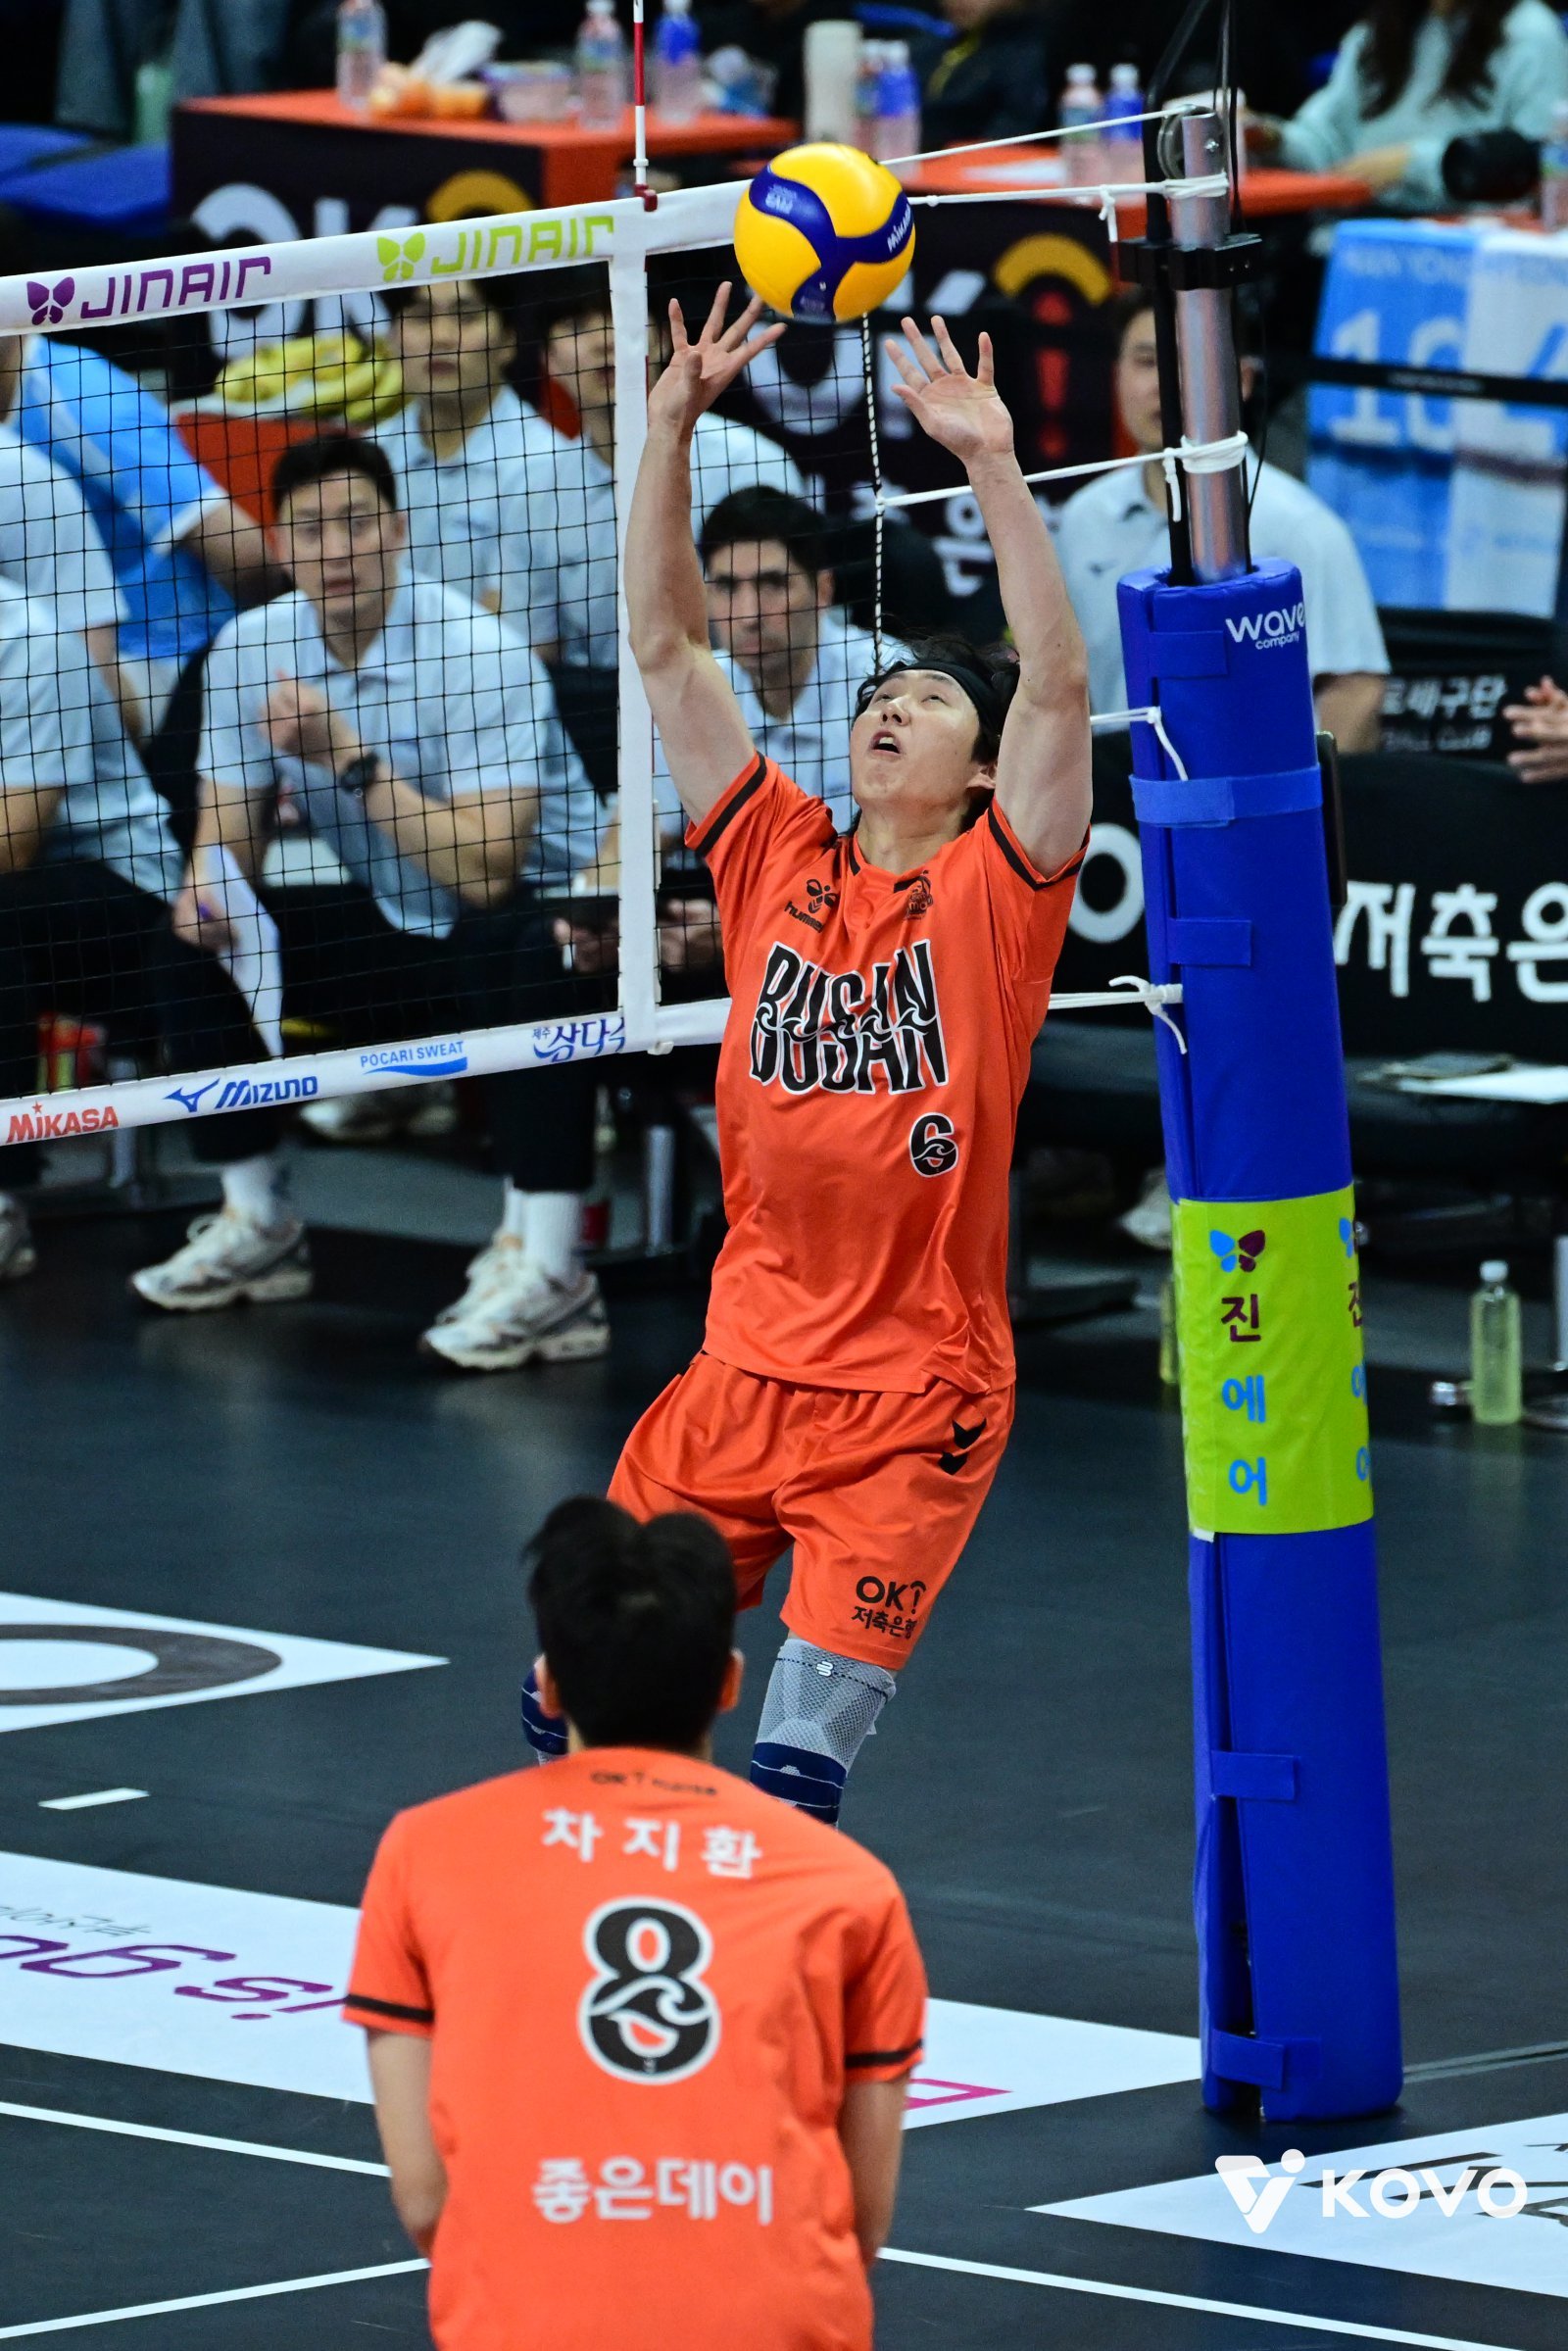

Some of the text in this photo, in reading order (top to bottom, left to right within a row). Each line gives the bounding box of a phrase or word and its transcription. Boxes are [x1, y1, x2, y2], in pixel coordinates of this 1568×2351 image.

[80, 257, 271, 318] JINAIR
[1225, 602, 1306, 643] wave
[749, 938, 950, 1096] BUSAN
[360, 1040, 465, 1068] POCARI SWEAT
[908, 1111, 959, 1177] 6
[851, 1605, 917, 1640] 저축은행
[576, 1893, 722, 2086] 8
[531, 2155, 772, 2226] 좋은데이
